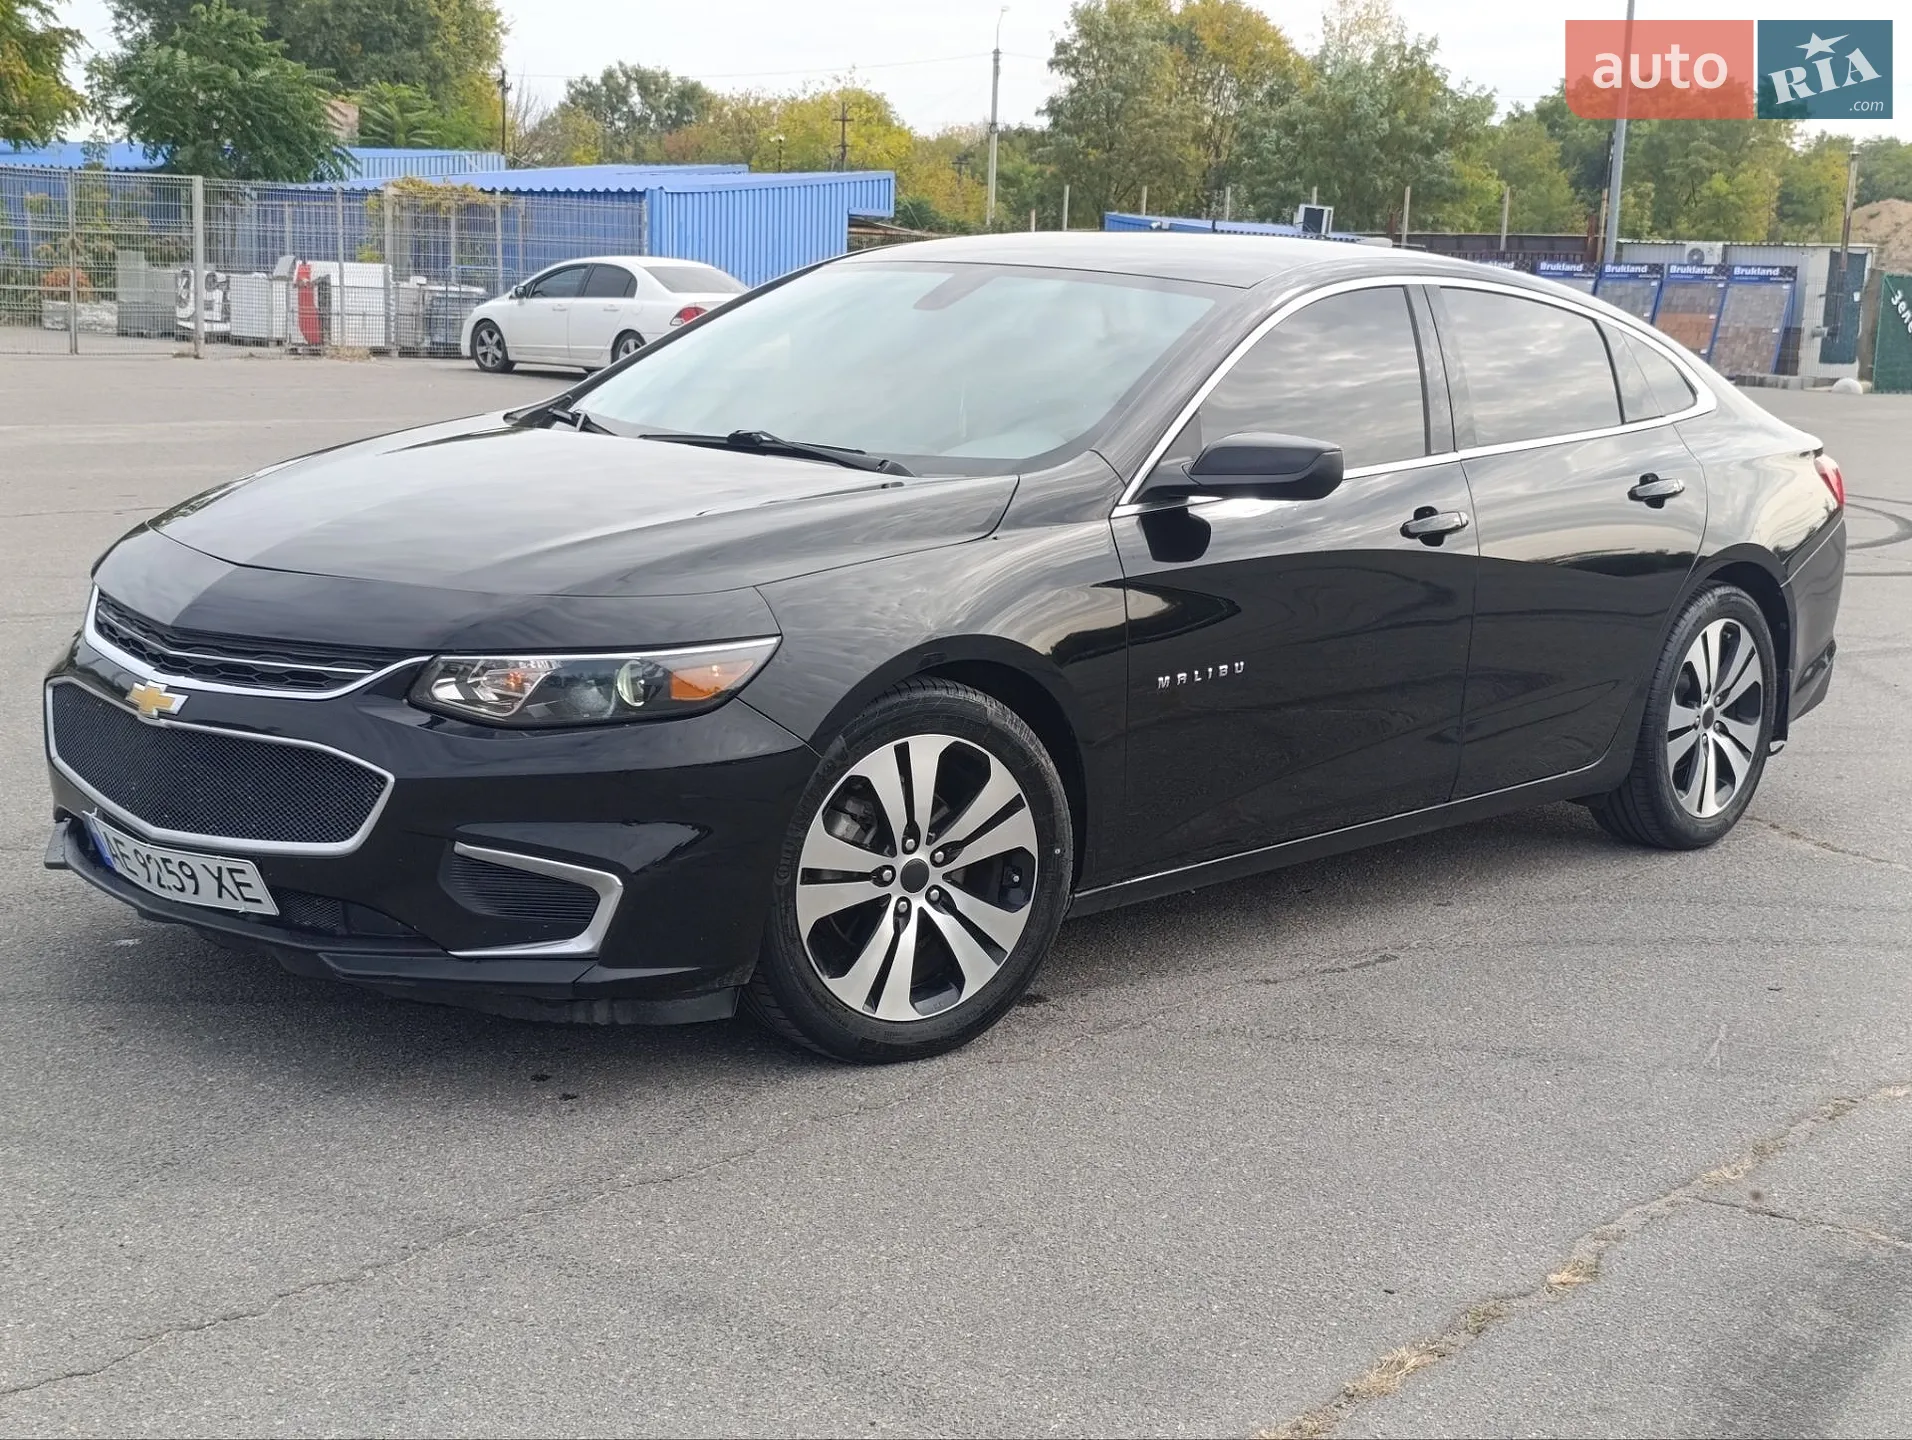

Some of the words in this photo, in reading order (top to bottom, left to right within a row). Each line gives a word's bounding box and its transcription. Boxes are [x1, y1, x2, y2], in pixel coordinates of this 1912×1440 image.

[1540, 261, 1584, 272] Brukland
[1604, 264, 1648, 274] Brukland
[1669, 265, 1714, 275] Brukland
[1733, 266, 1780, 276] Brukland
[1157, 661, 1245, 689] MALIBU
[200, 863, 264, 904] XE
